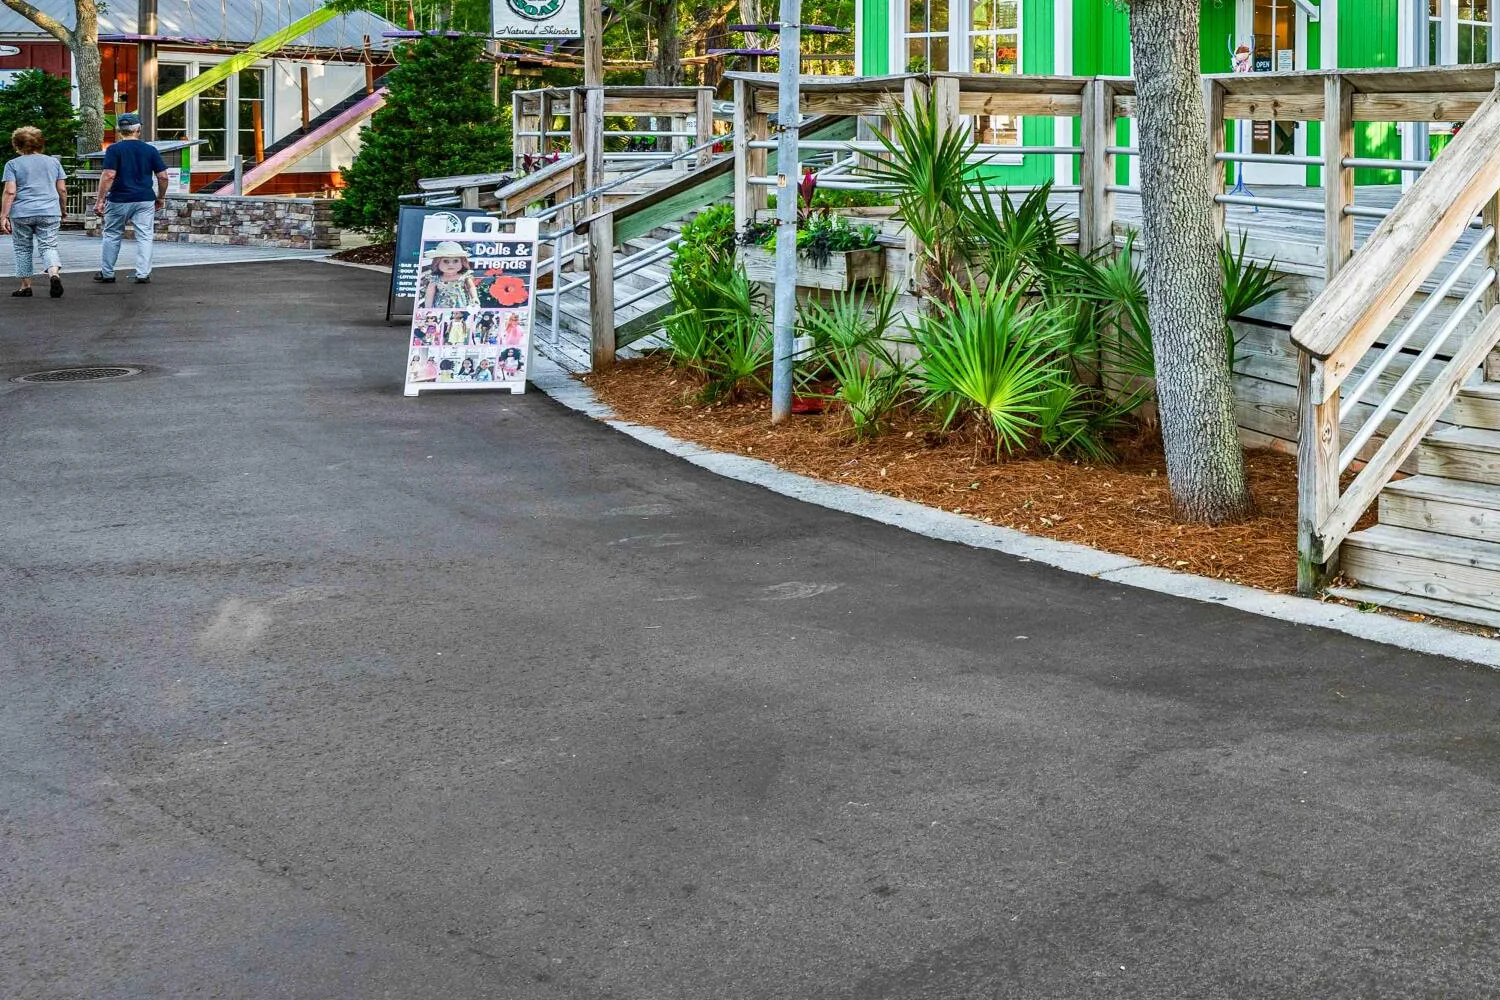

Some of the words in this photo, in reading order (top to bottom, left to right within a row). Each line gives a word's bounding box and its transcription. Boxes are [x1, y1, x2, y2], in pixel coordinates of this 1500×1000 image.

[496, 24, 538, 35] Natural
[539, 25, 578, 35] Skincare
[475, 243, 511, 256] Dolls
[515, 244, 529, 256] &
[474, 258, 527, 270] Friends
